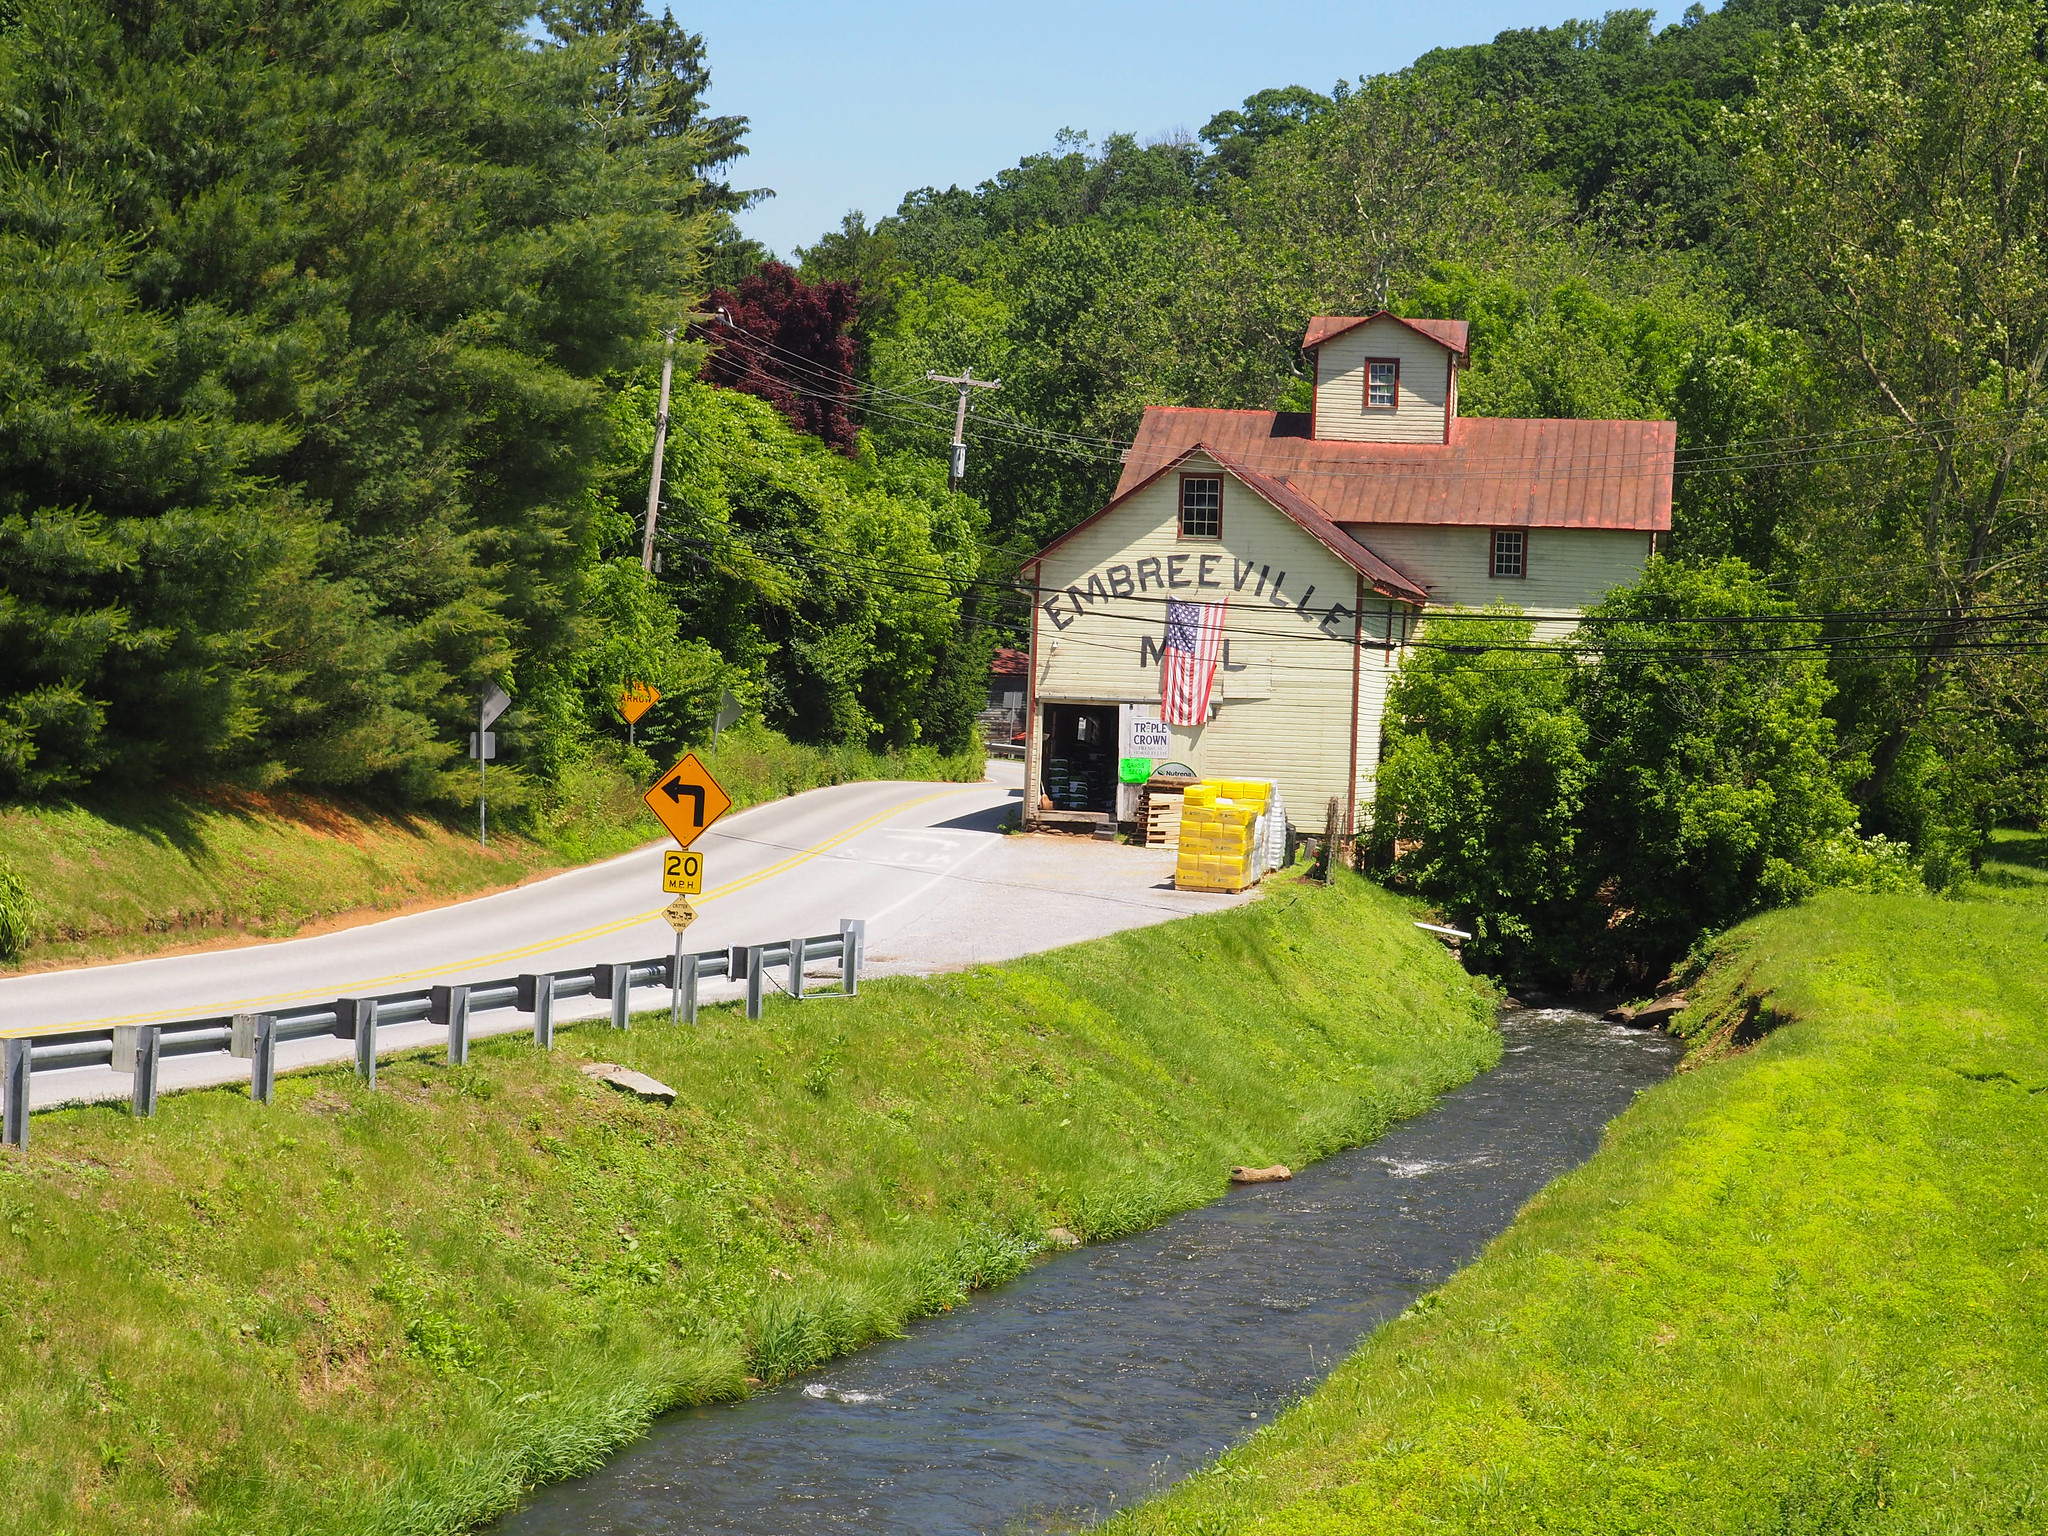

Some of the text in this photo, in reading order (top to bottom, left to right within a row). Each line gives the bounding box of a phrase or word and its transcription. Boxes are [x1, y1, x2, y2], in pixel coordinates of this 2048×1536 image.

[1042, 554, 1355, 639] EMBREEVILLE
[1140, 635, 1247, 672] ML
[1133, 734, 1167, 745] CROWN
[667, 855, 698, 877] 20
